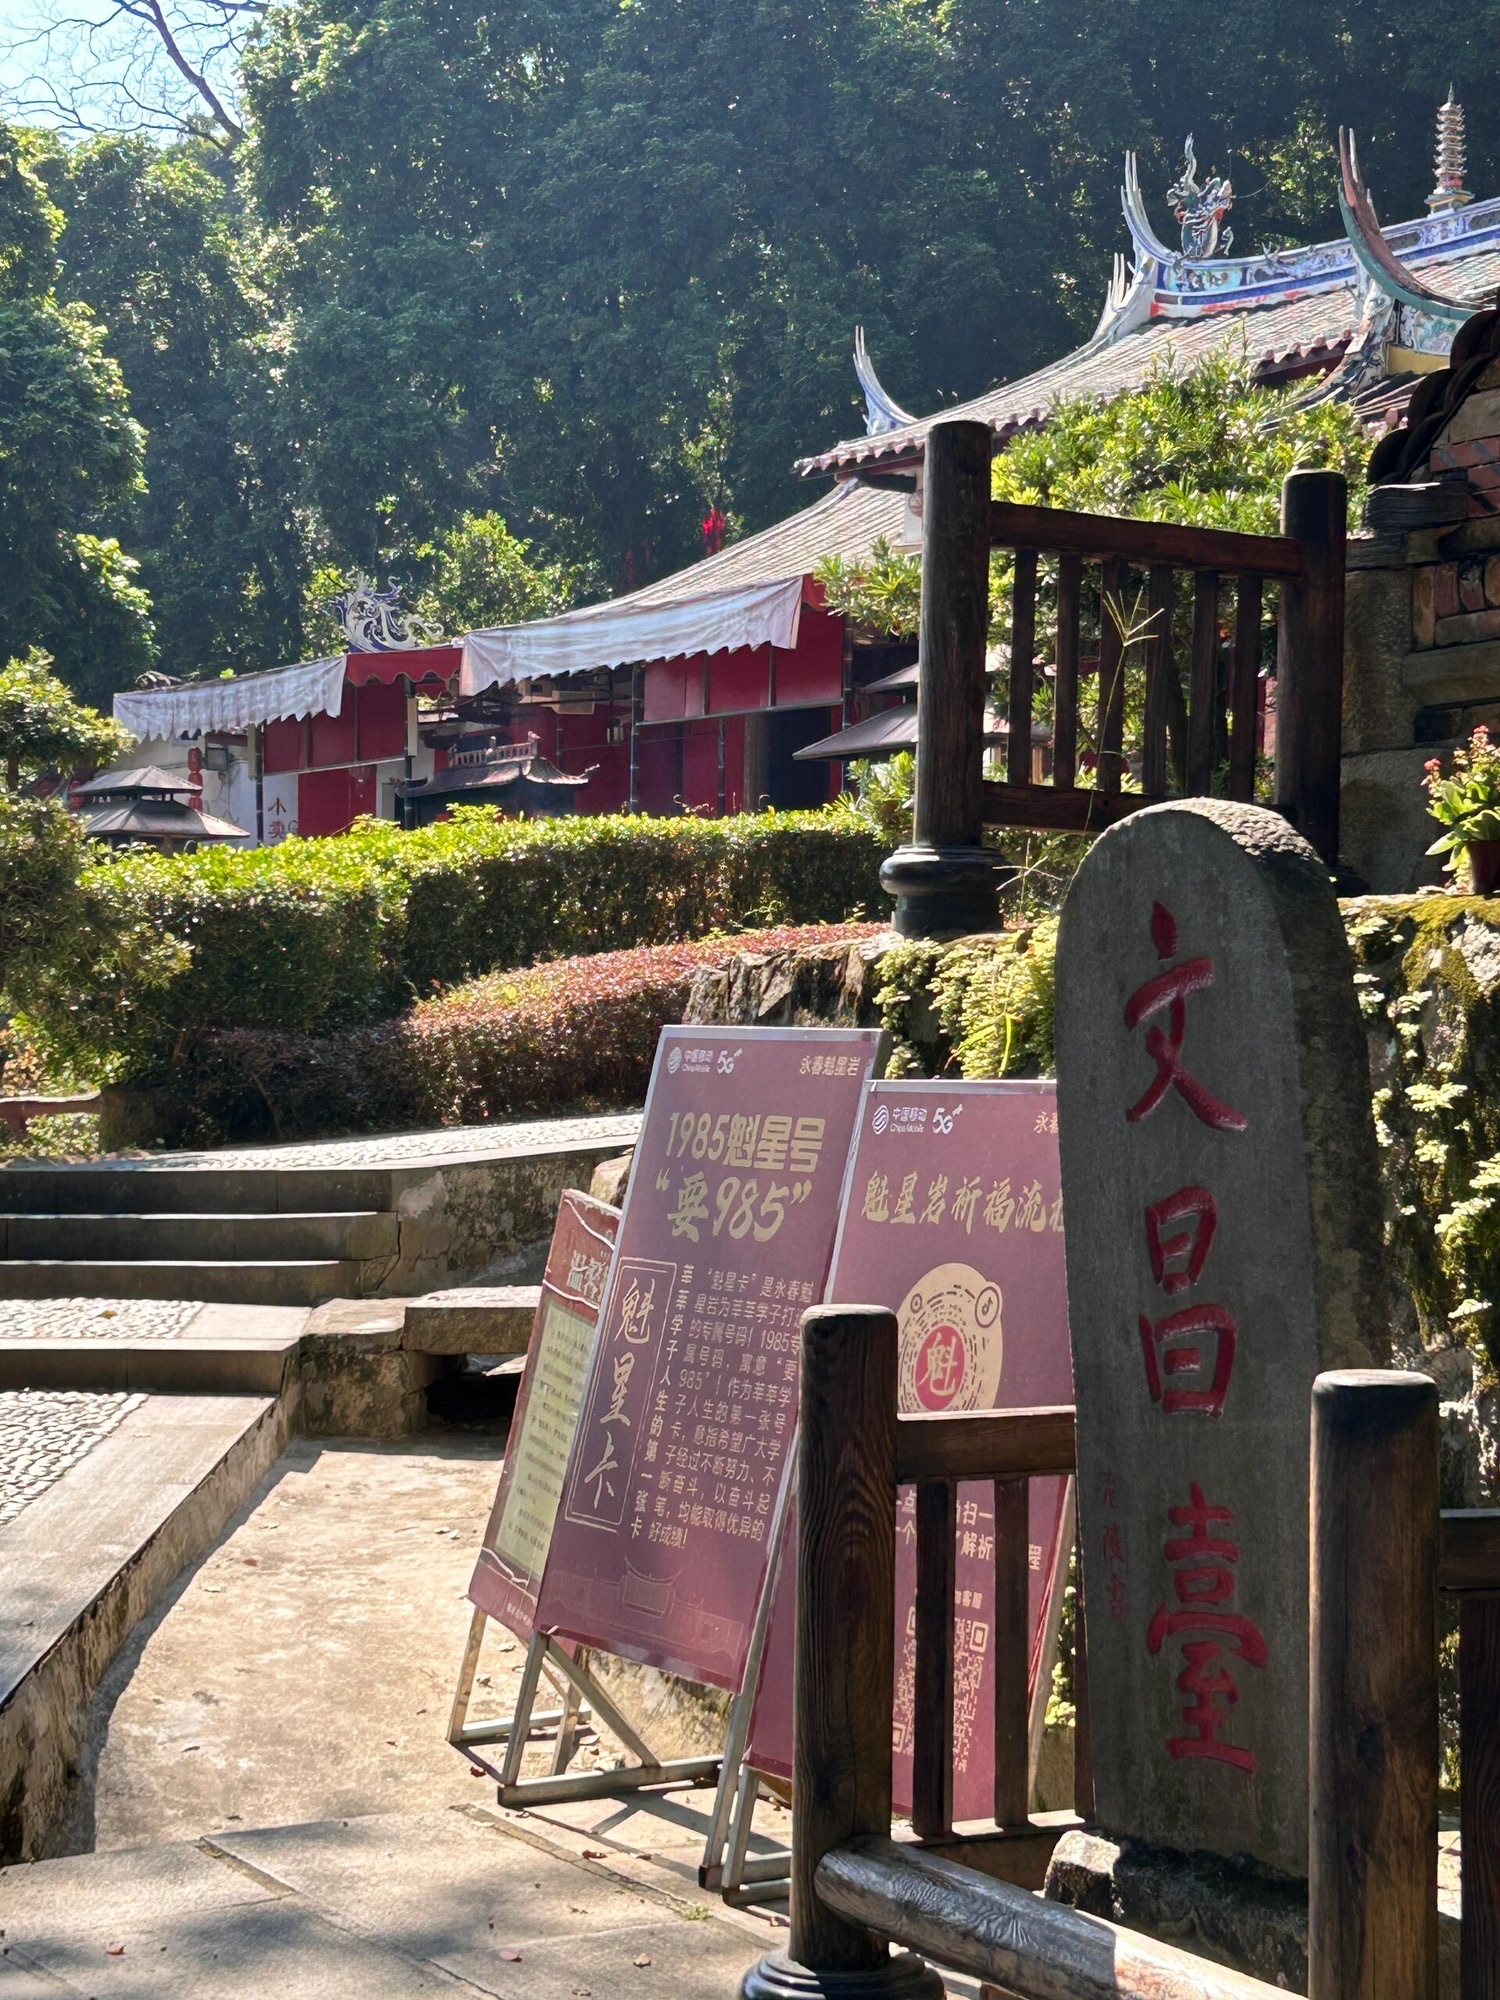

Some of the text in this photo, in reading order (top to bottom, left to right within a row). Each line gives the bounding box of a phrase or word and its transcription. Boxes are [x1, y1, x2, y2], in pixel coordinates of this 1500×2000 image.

[800, 1055, 861, 1076] 永春魁星岩
[892, 1107, 928, 1122] 中国移动
[932, 1107, 954, 1134] 5G
[665, 1112, 826, 1173] 1985魁星号
[584, 1277, 655, 1510] 魁星卡
